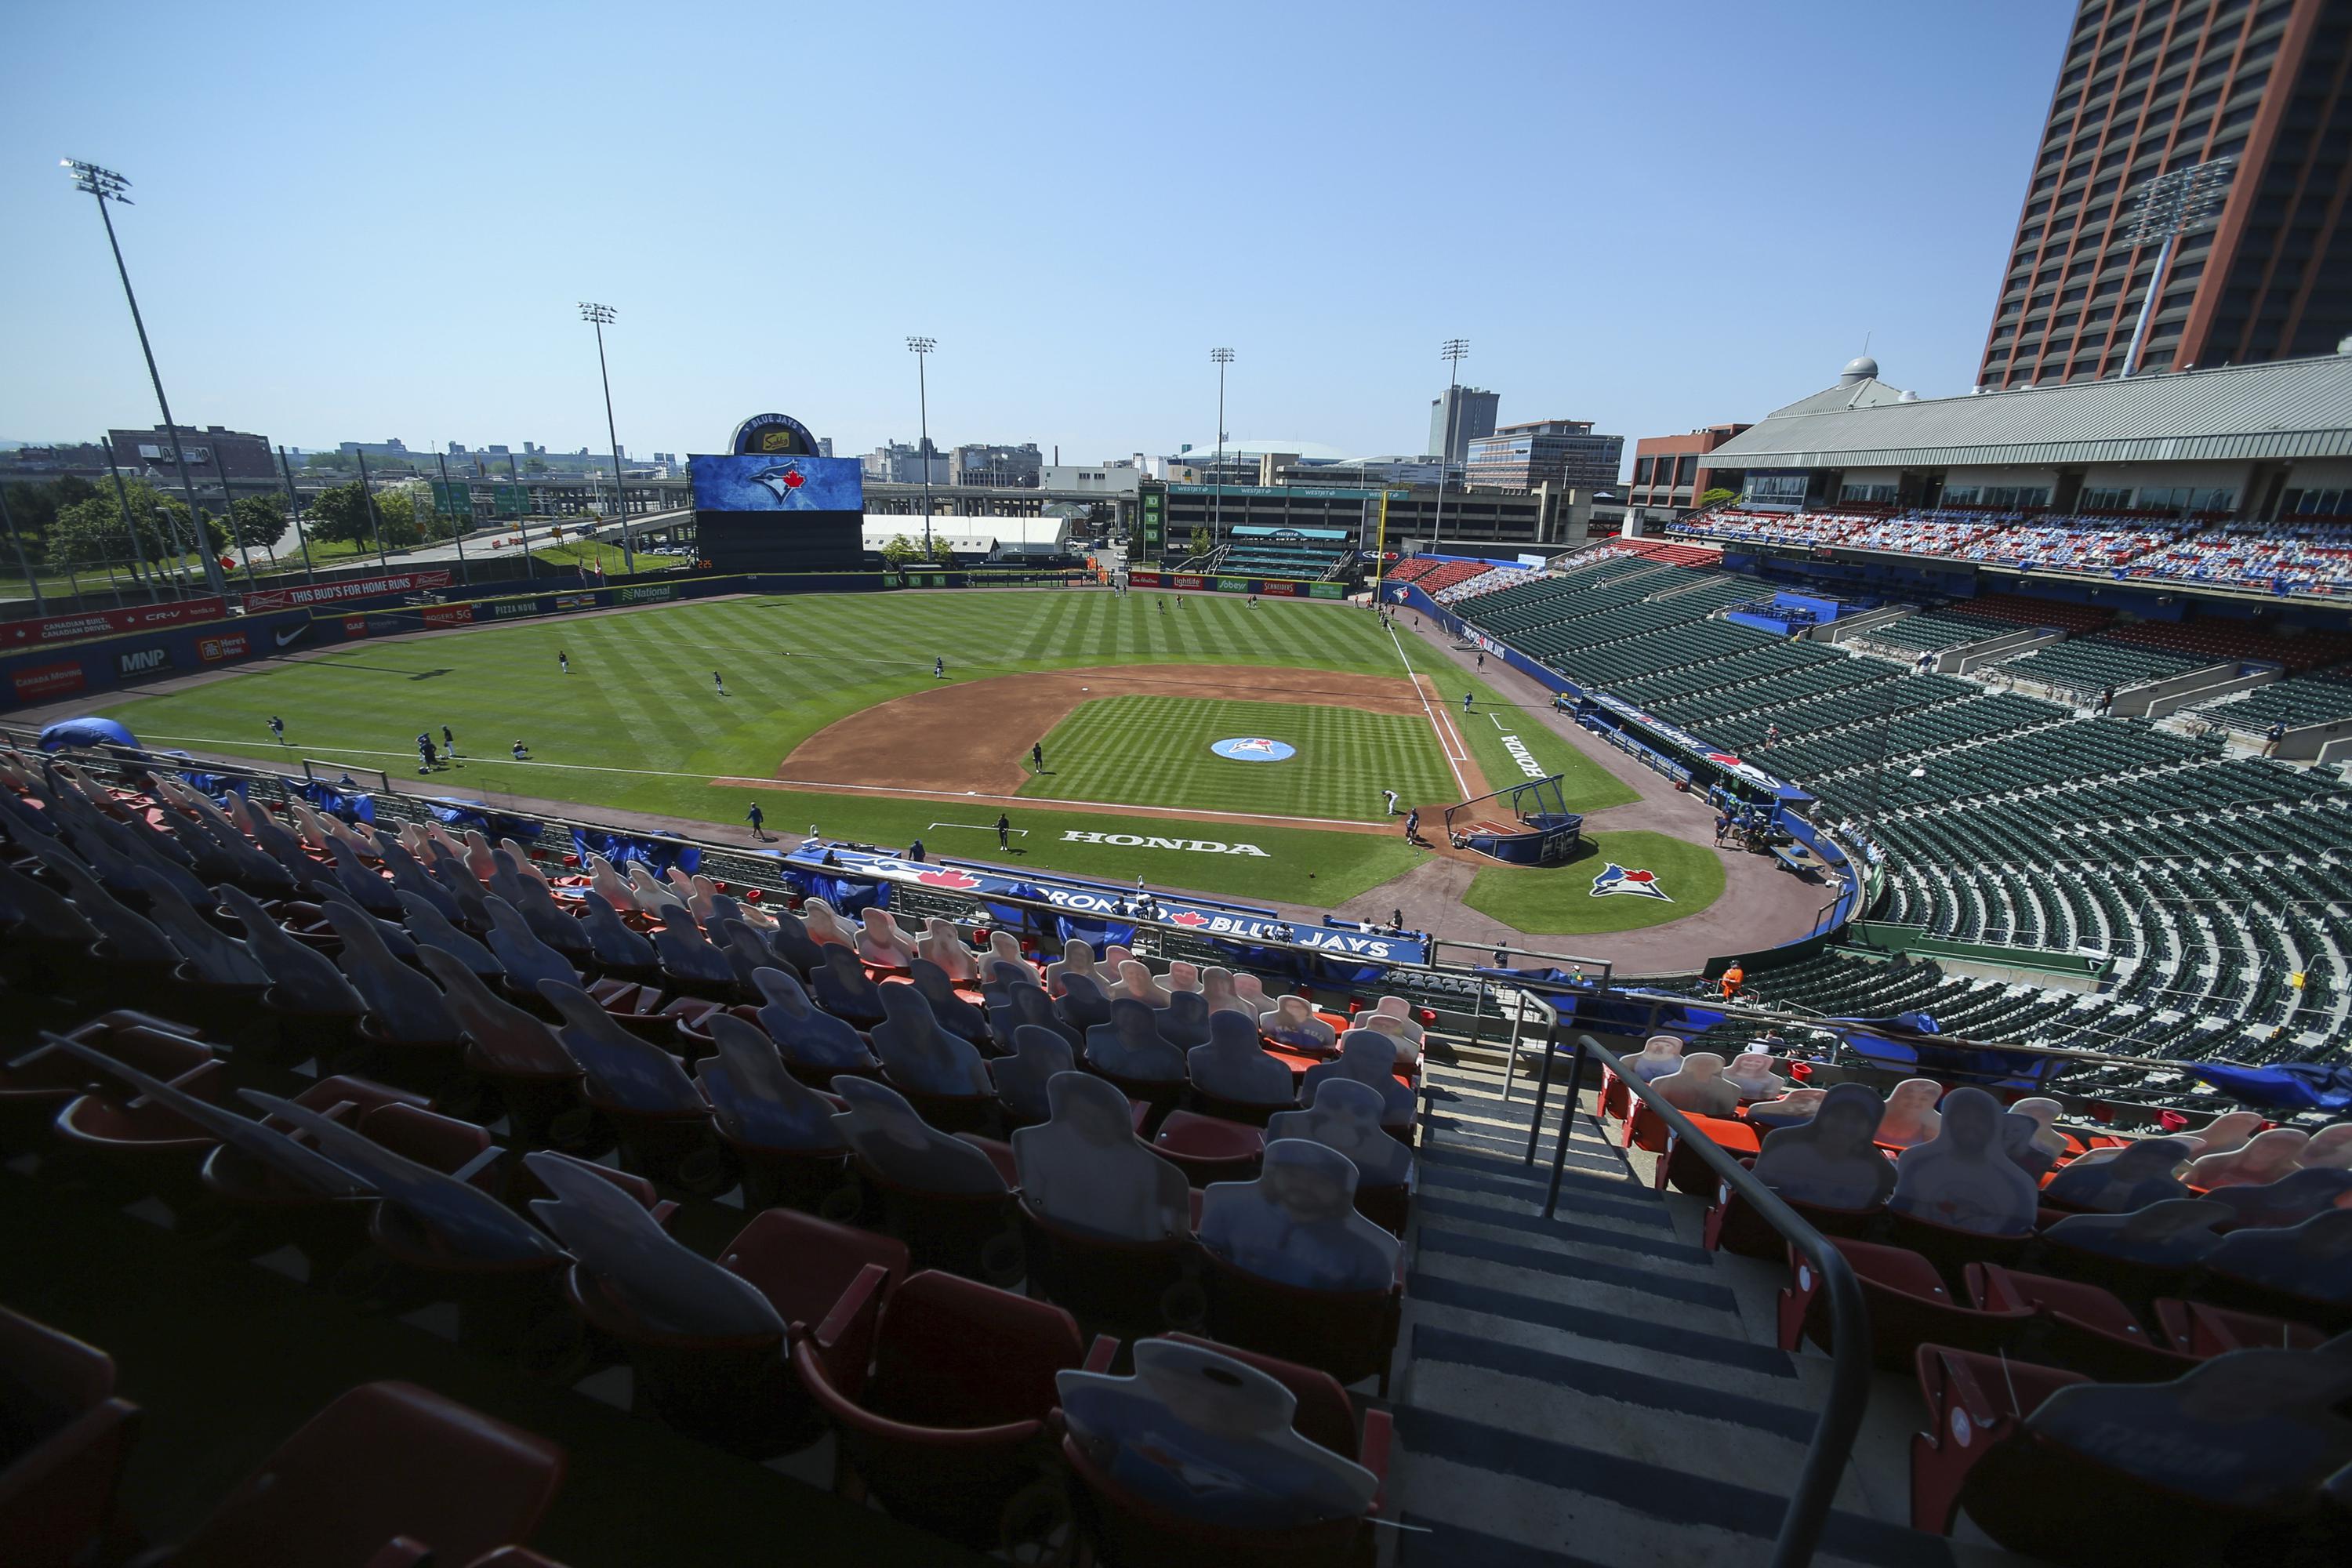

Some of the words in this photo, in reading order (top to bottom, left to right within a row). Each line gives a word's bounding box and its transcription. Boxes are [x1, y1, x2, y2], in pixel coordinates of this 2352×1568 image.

[751, 415, 774, 428] BLUE
[776, 416, 798, 429] JAYS
[1174, 577, 1200, 587] Lightlife
[291, 590, 314, 603] THIS
[314, 586, 342, 601] BUD'S
[343, 585, 361, 596] FOR
[363, 581, 388, 593] HOME
[389, 578, 411, 590] RUNS
[633, 585, 670, 598] National
[426, 612, 454, 621] ROGERS
[456, 609, 471, 619] 5G
[495, 604, 516, 615] PIZZA
[518, 602, 537, 613] NOVA
[146, 610, 181, 621] CR-V
[42, 627, 83, 639] CANADIAN
[85, 623, 114, 633] DRIVEN.
[44, 620, 85, 630] CANADIAN
[347, 622, 365, 630] GAF
[122, 649, 165, 672] MNP
[16, 676, 49, 687] CANADA
[1501, 735, 1548, 779] HONDA
[1059, 829, 1272, 857] HONDA
[1299, 931, 1390, 958] JAYS
